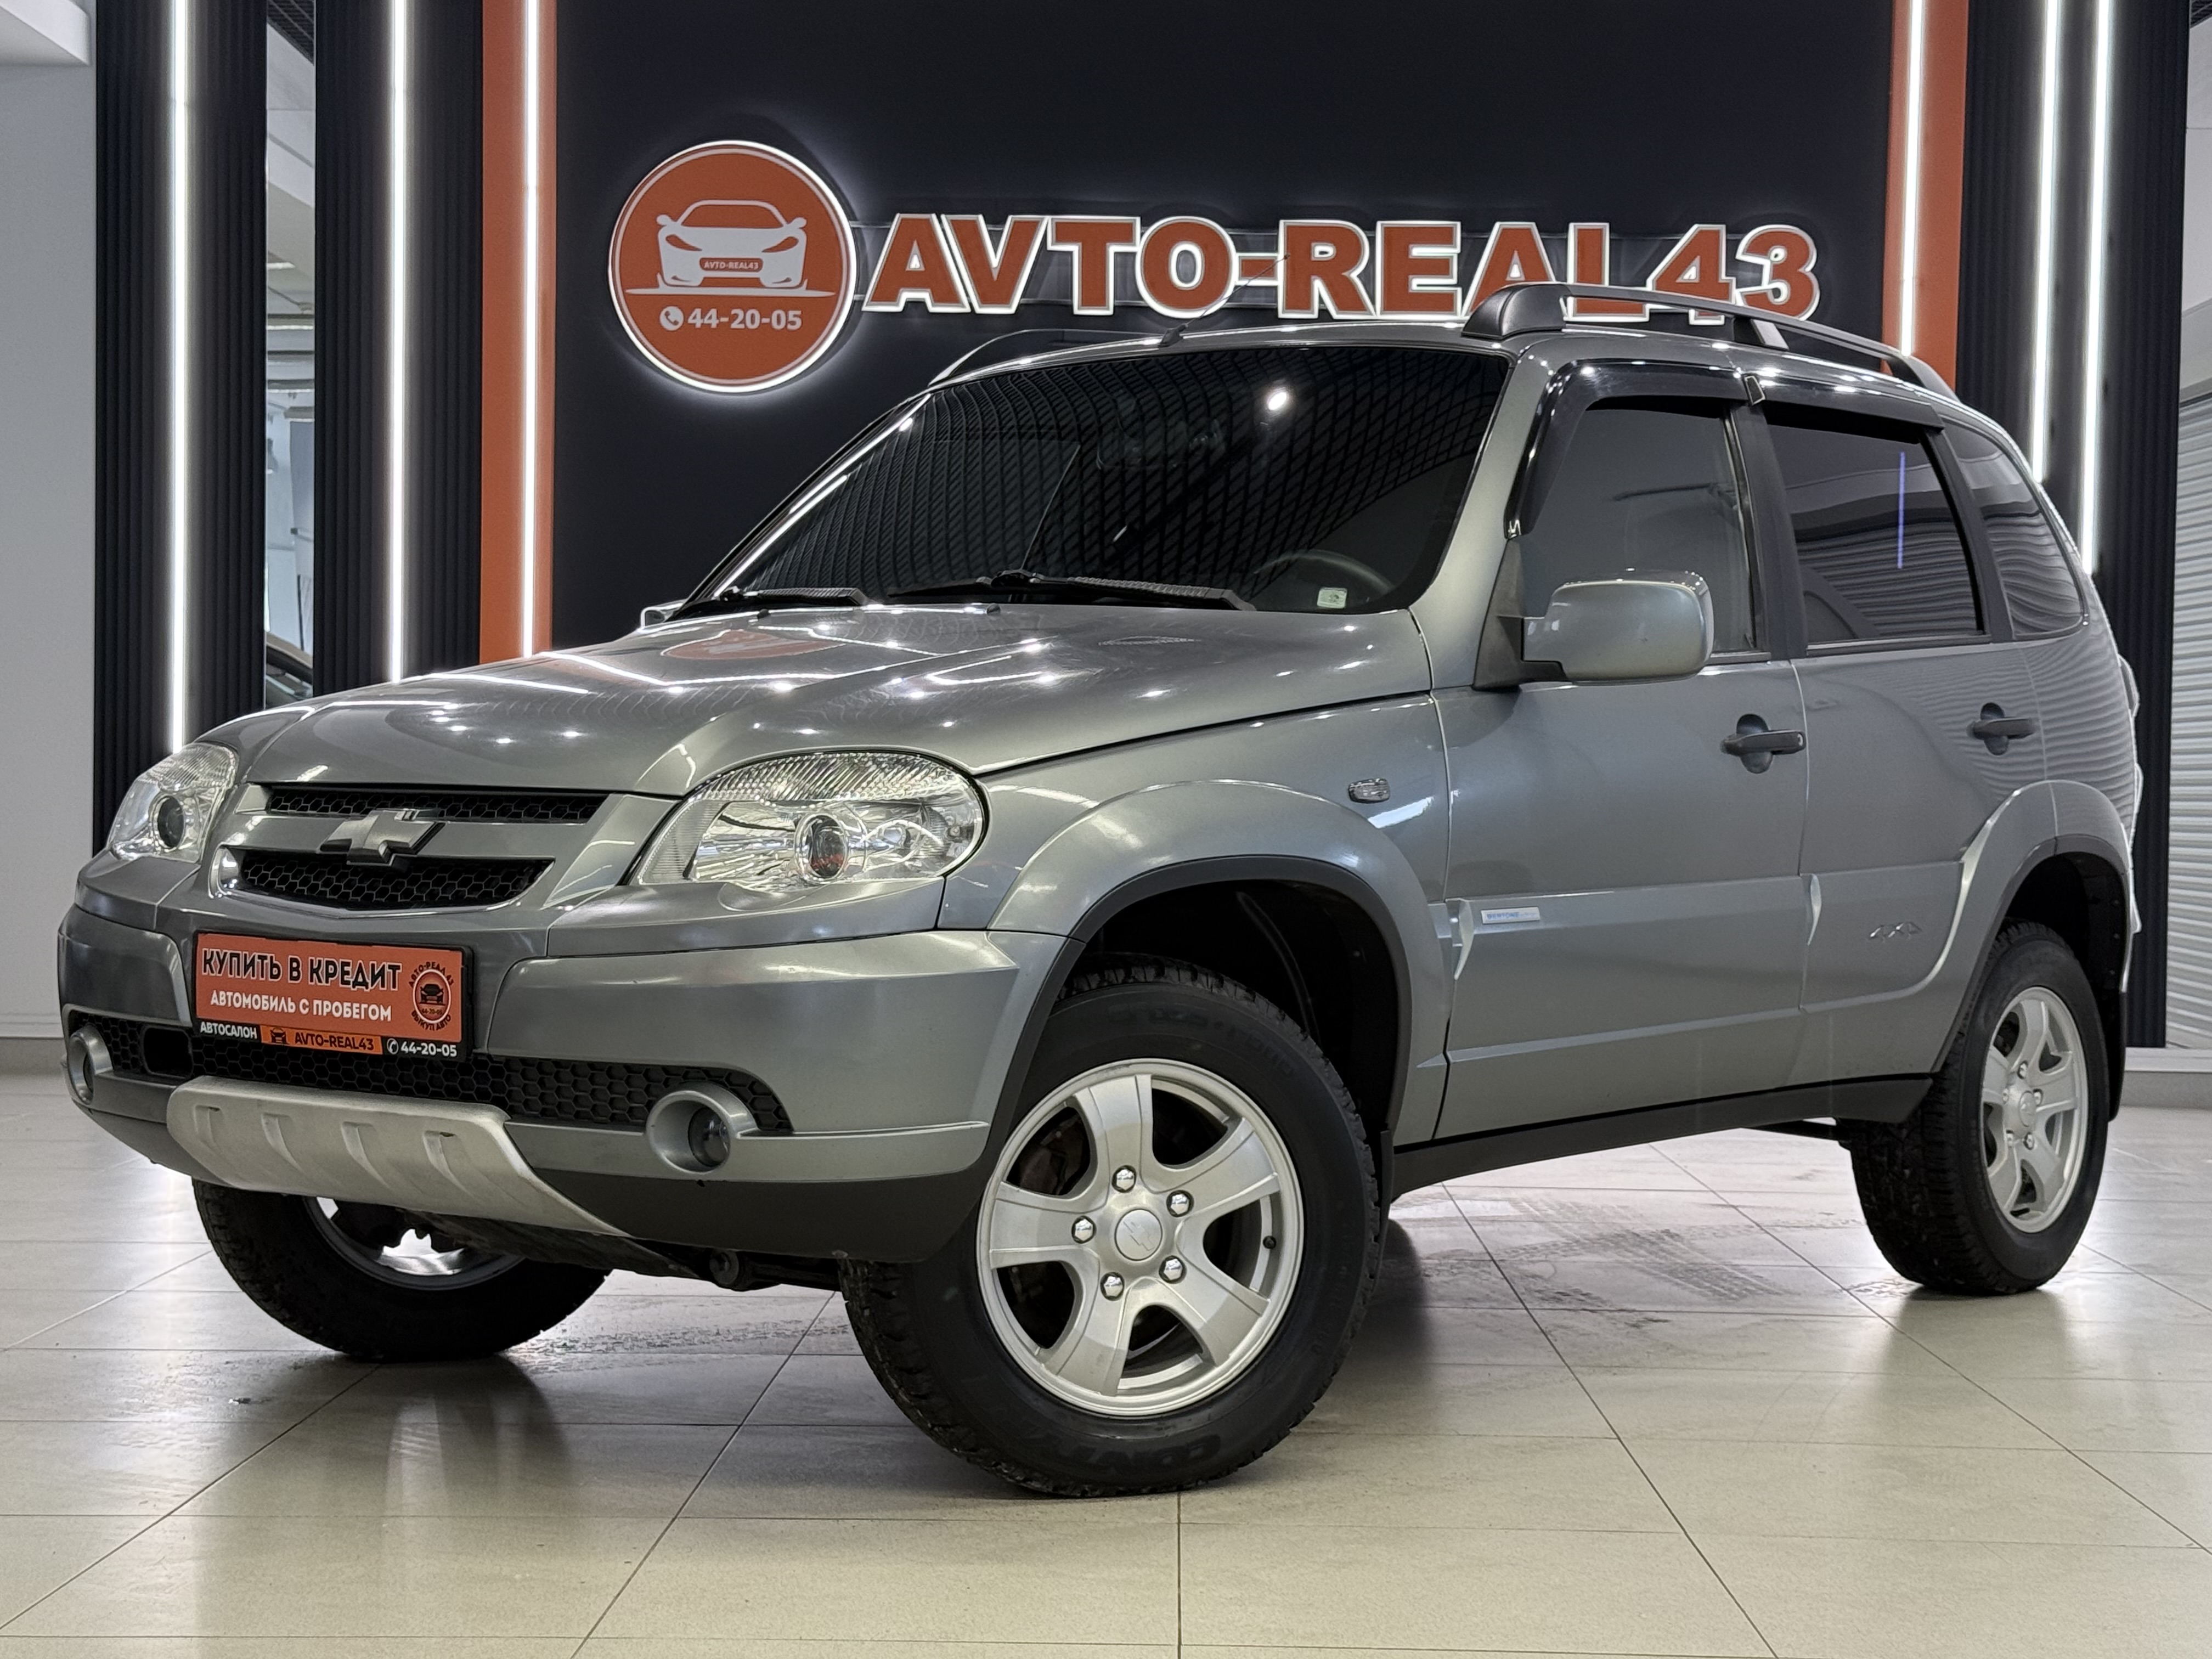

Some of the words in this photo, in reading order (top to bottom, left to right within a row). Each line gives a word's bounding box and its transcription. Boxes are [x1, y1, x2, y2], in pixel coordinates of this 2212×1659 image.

[704, 261, 759, 269] AVTO-REAL43
[687, 308, 802, 330] 44-20-05
[202, 947, 283, 982] КУПИТЬ
[287, 955, 303, 984] В
[308, 956, 402, 992] КРЕДИТ
[210, 990, 296, 1013] АВТОМОБИЛЬ
[299, 998, 309, 1015] С
[313, 1000, 392, 1022] ПРОБЕГОМ
[200, 1021, 258, 1040] АВТОСАЛОН
[436, 1014, 452, 1031] АВТО
[294, 1032, 375, 1051] AVTO-REAL43
[400, 1041, 458, 1057] 44-20-05
